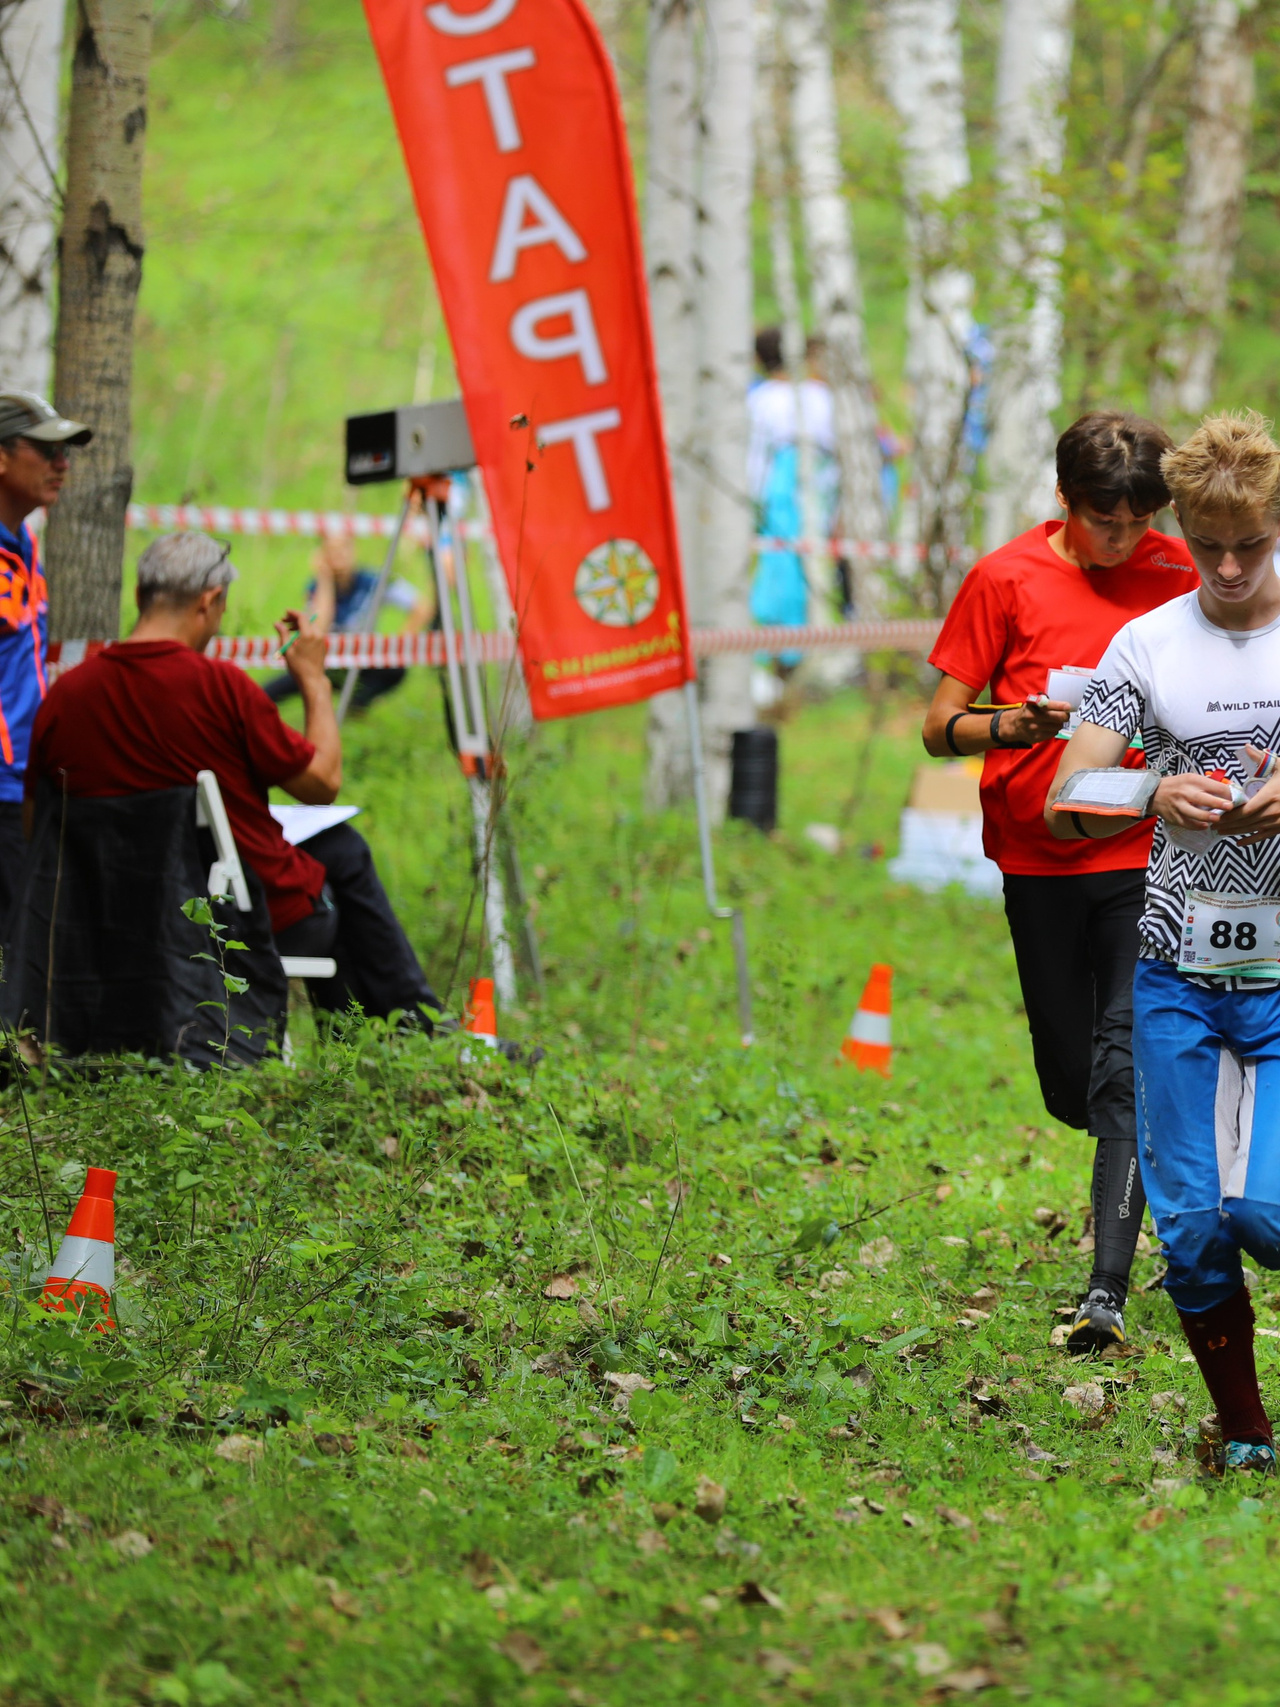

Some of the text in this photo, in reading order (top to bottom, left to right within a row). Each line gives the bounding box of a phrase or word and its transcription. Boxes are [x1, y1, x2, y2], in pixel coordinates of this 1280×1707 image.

[1222, 702, 1250, 711] WILD
[1209, 920, 1257, 950] 88
[1123, 1157, 1137, 1203] NORD
